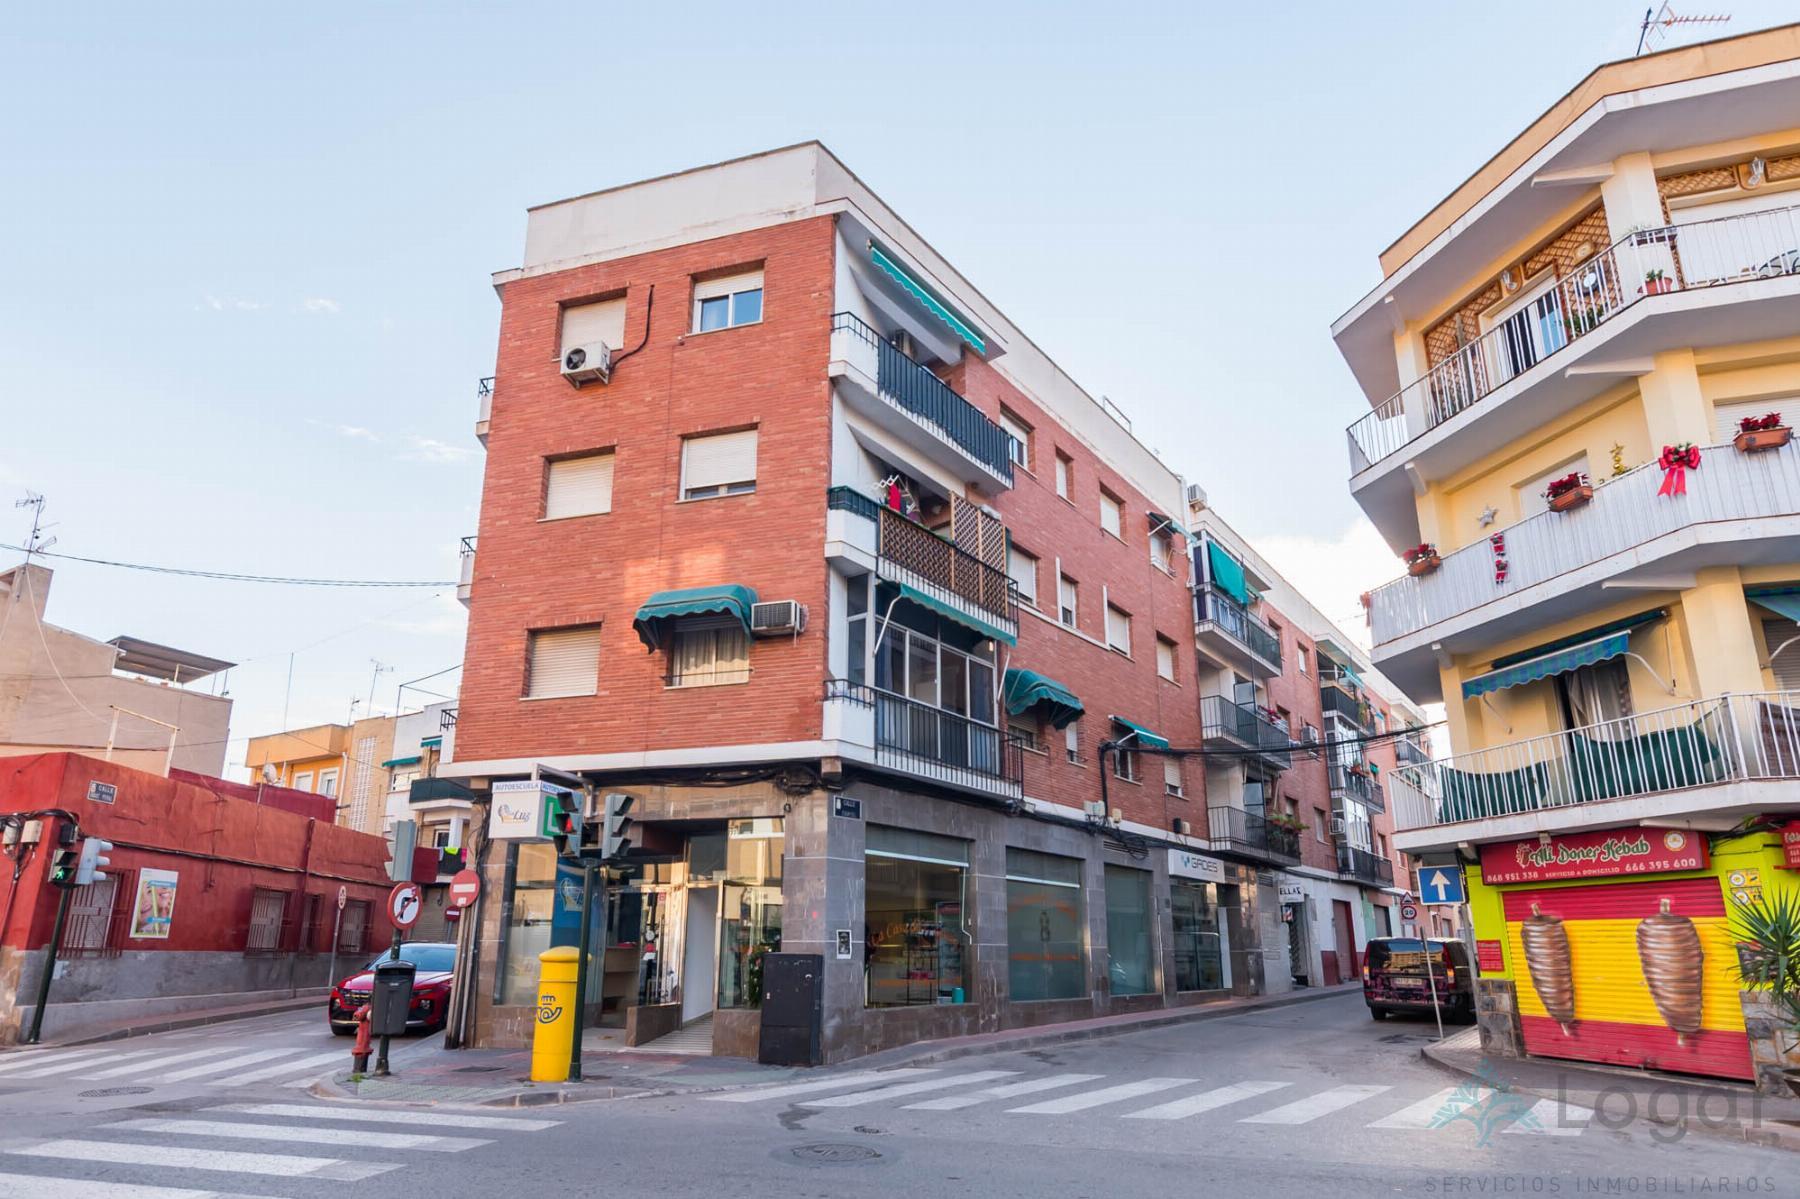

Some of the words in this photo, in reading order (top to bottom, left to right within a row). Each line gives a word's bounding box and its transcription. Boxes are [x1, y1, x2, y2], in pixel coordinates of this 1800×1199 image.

[1529, 845, 1556, 867] Ali
[1557, 843, 1599, 864] Doner
[1600, 834, 1650, 862] Kebab
[1582, 867, 1620, 876] DOMICILIO
[1625, 863, 1646, 872] 666
[1649, 860, 1670, 870] 395
[1673, 858, 1697, 868] 600
